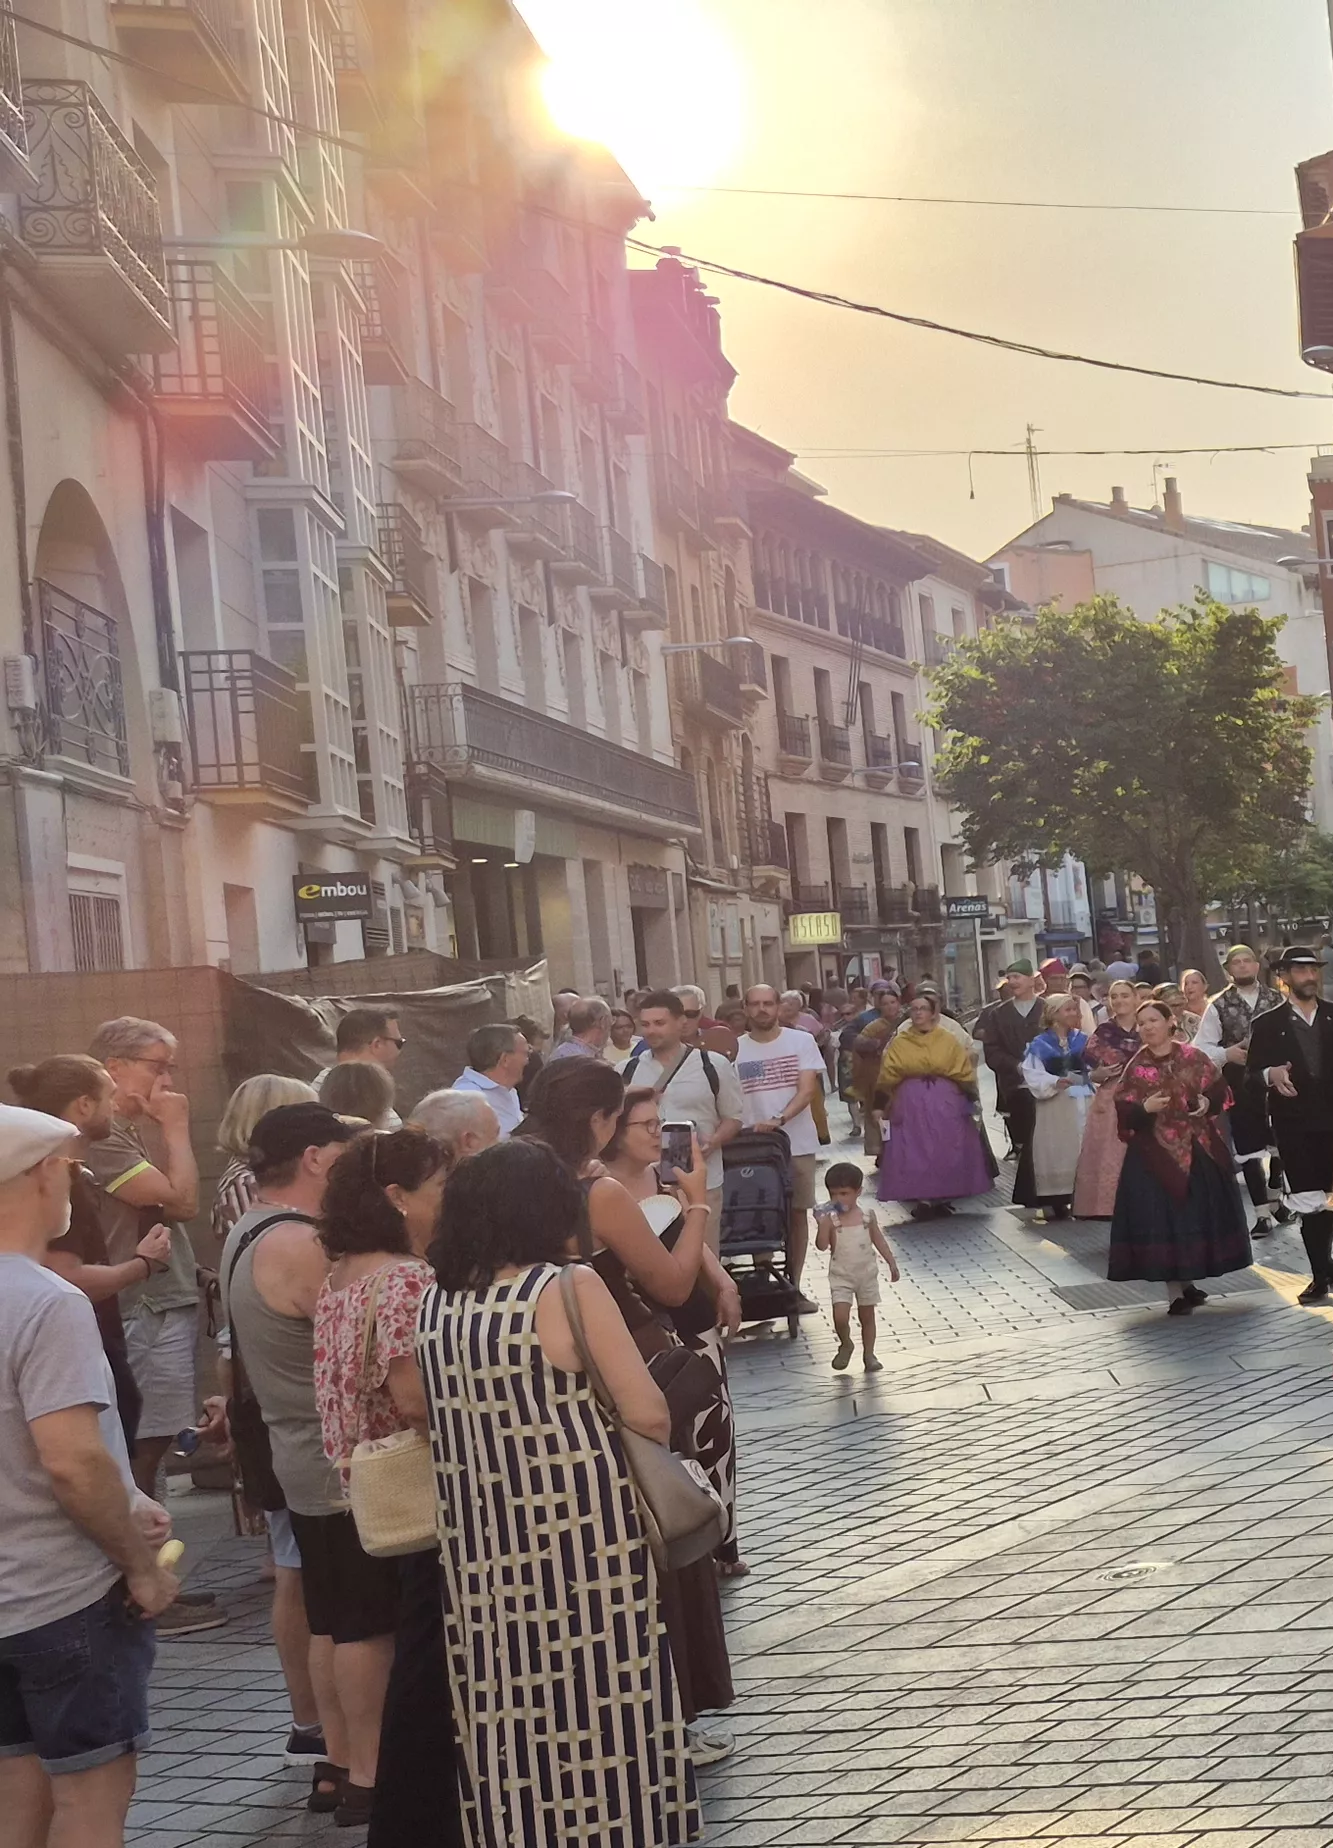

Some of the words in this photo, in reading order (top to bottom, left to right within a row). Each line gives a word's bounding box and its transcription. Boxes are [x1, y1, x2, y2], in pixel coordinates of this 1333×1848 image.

[298, 881, 367, 899] embou
[949, 902, 987, 913] Arenas
[792, 914, 838, 938] ASCASO
